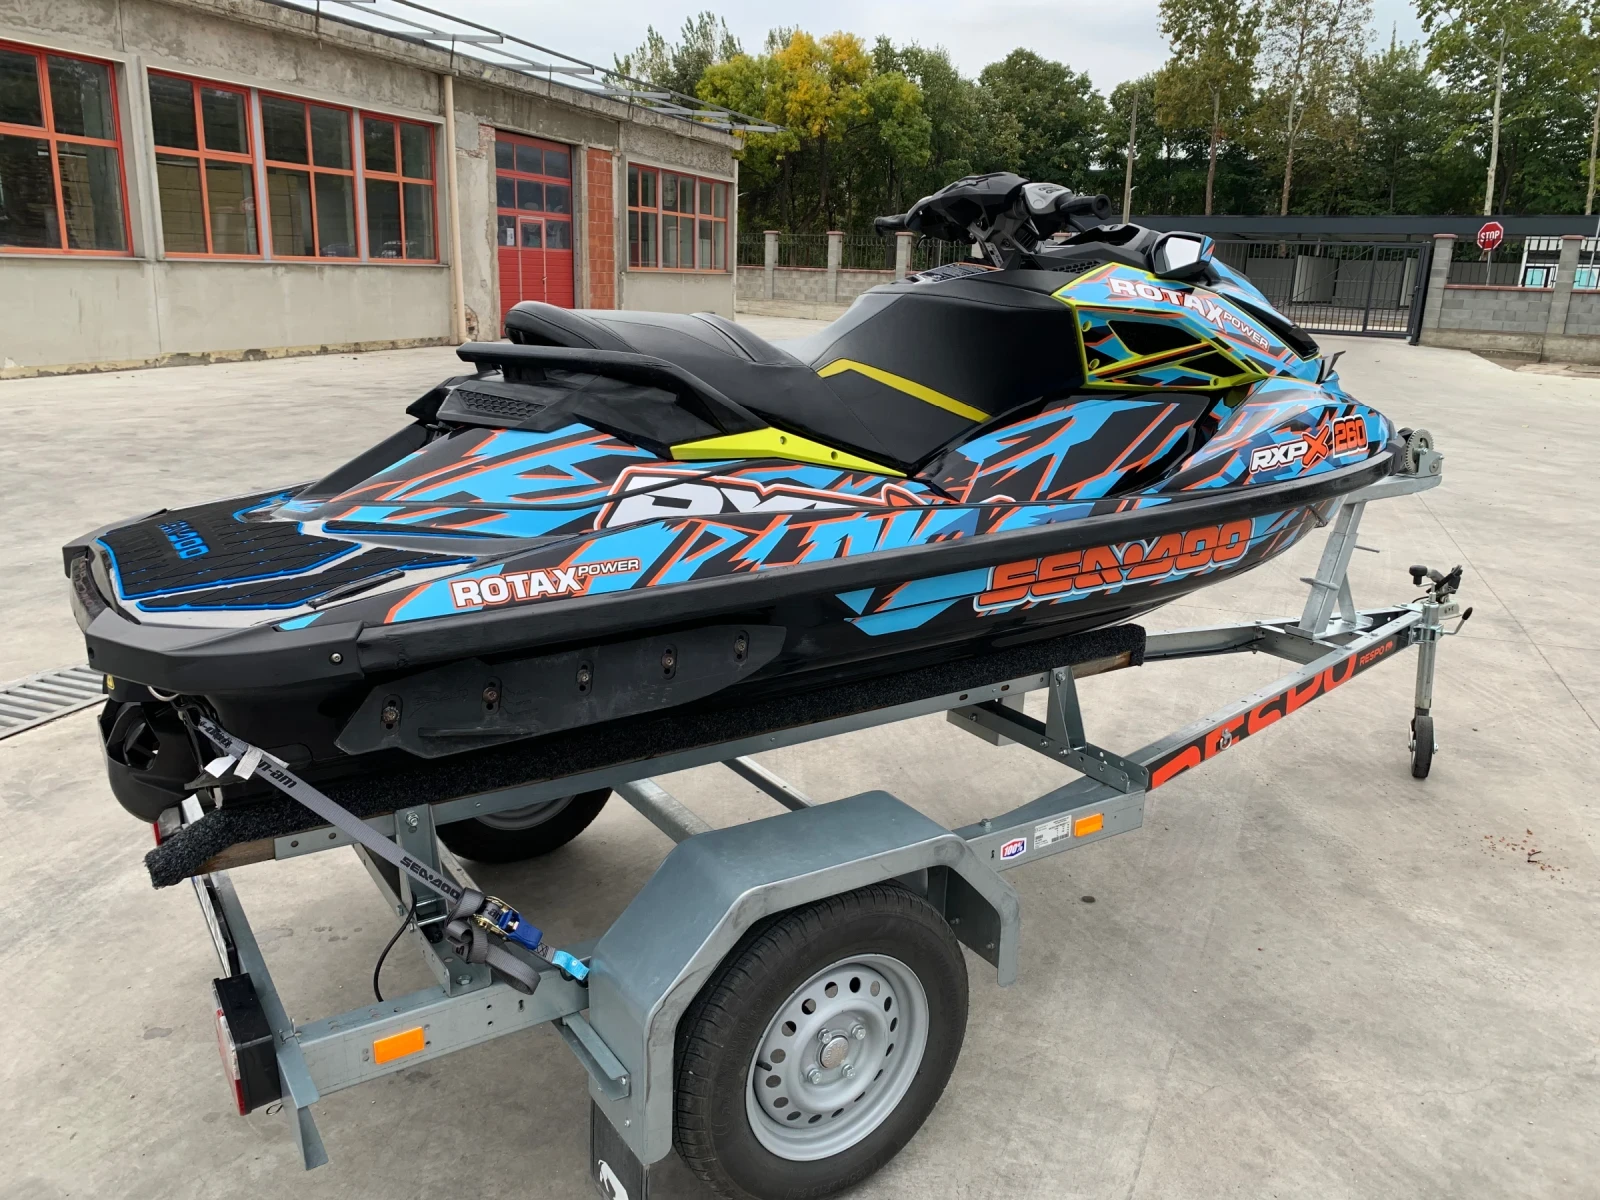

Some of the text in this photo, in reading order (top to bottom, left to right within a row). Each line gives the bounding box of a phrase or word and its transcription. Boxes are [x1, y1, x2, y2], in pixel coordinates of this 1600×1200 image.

[1481, 230, 1500, 242] STOP
[1108, 278, 1269, 350] ROTAX POWER
[1332, 416, 1368, 455] 260
[451, 559, 640, 608] ROTAX POWER
[1360, 645, 1385, 666] RESPO
[1003, 840, 1025, 857] 100%
